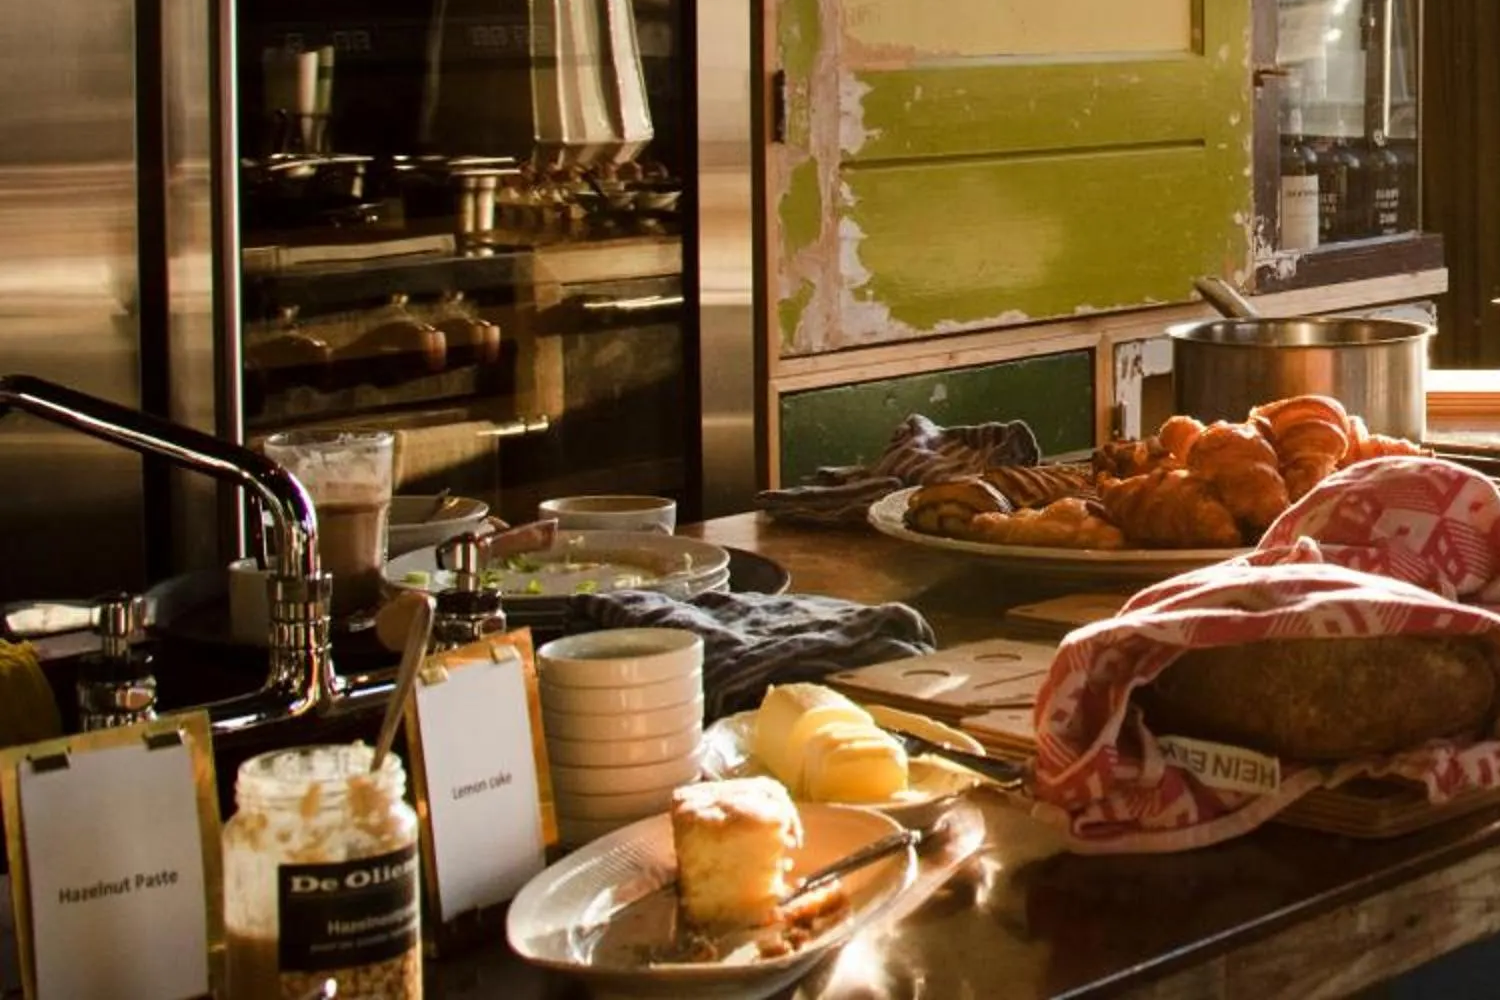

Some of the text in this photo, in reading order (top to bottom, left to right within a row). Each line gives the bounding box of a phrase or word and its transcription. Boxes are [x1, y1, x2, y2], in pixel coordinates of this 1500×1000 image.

[452, 770, 512, 801] Lemon cake
[1212, 753, 1277, 790] HEIN
[58, 871, 178, 904] Hazelnut Paste
[290, 874, 338, 893] De
